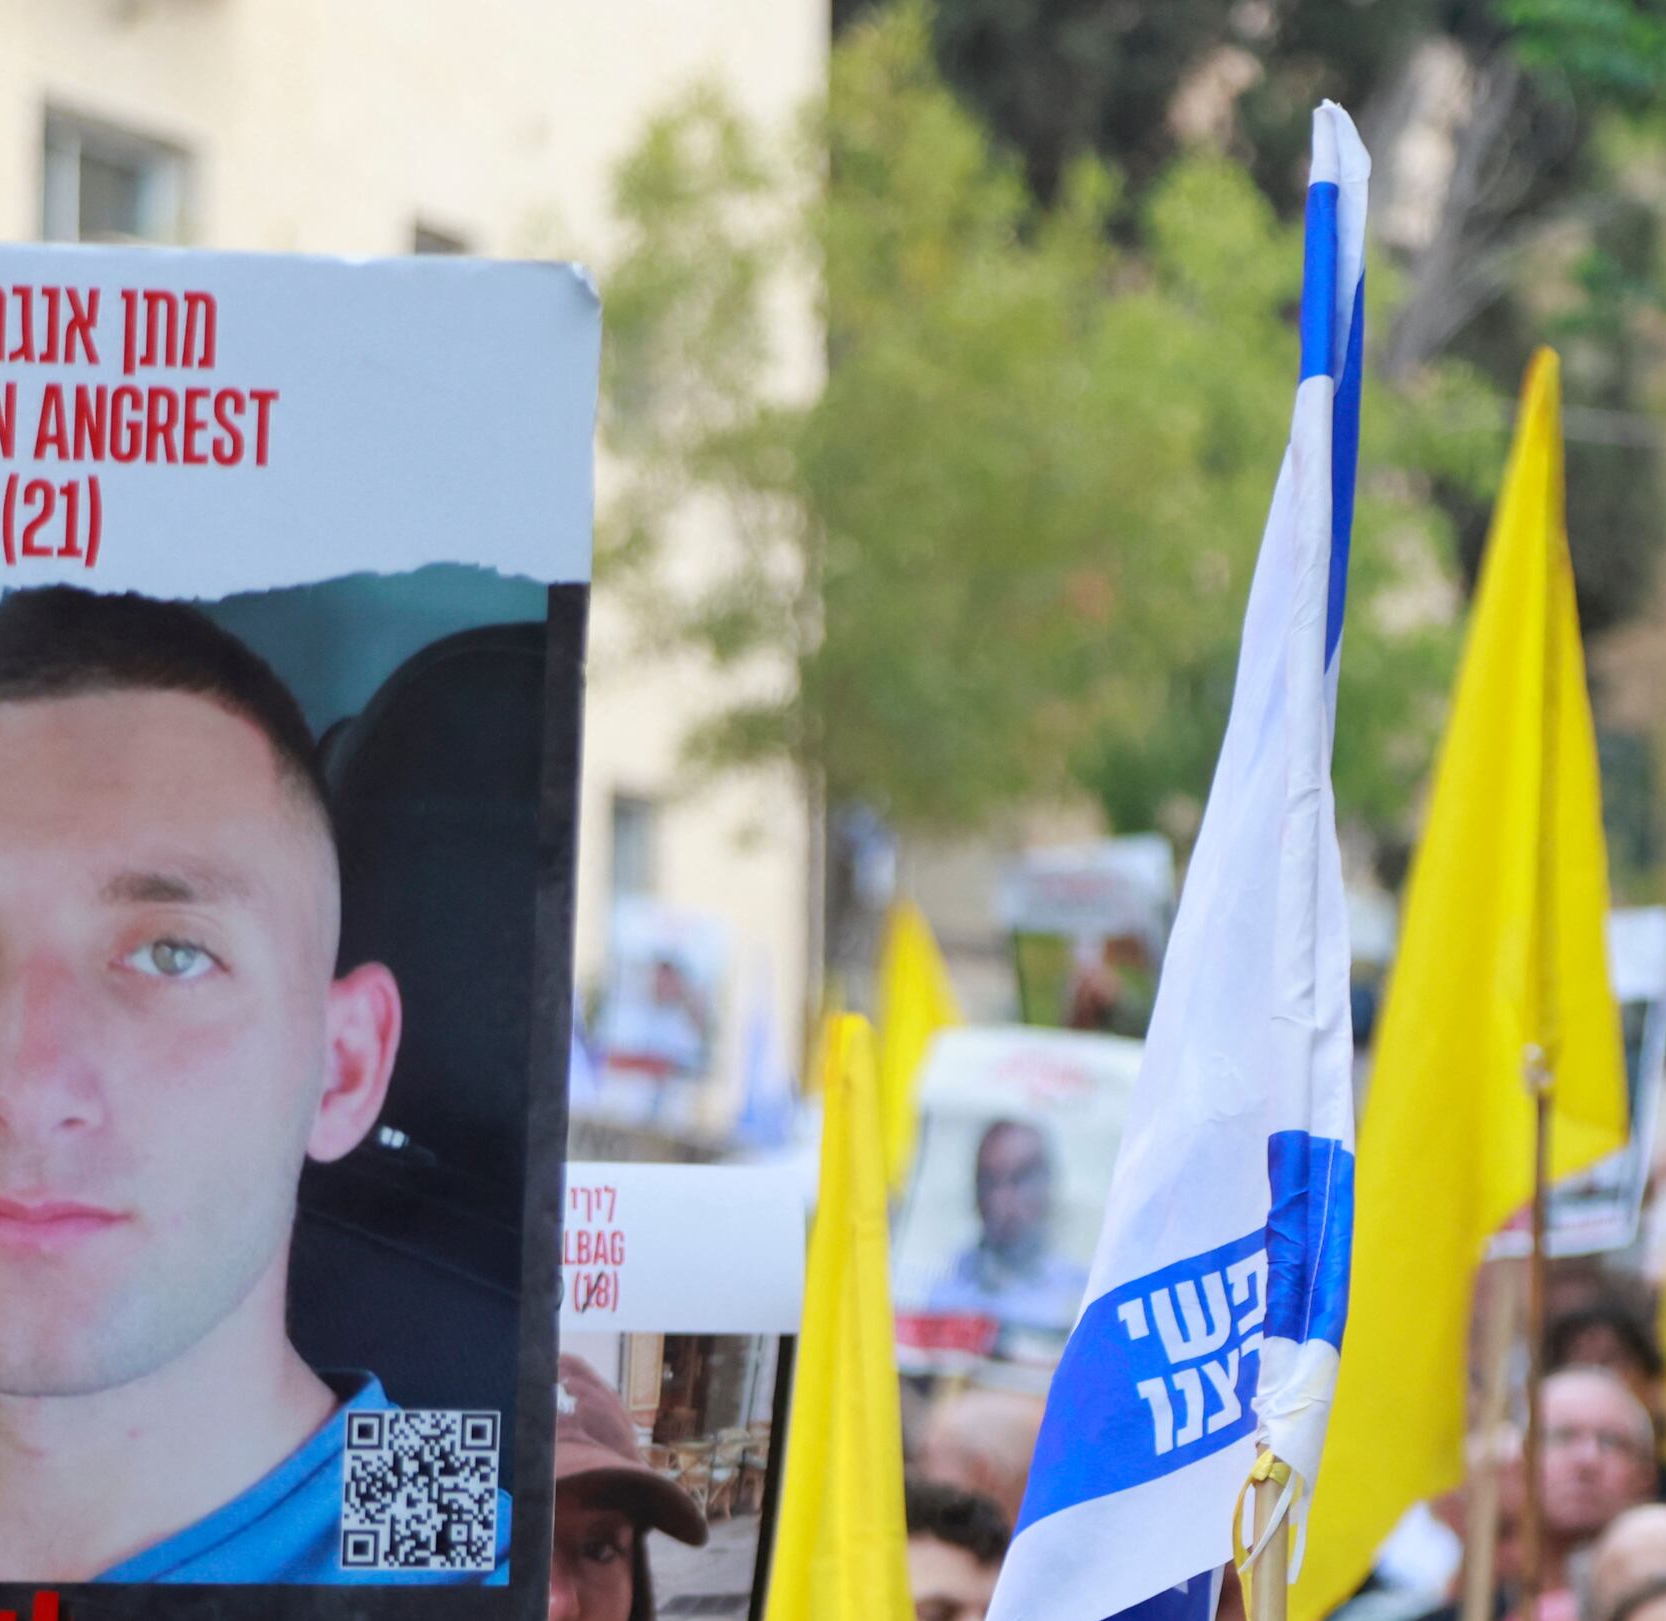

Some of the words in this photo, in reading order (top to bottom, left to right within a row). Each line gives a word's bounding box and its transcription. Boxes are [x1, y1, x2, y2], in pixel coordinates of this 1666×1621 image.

[121, 288, 218, 376] מתן
[34, 383, 280, 467] ANGREST
[2, 472, 103, 568] (21)
[571, 1185, 618, 1223] לירי
